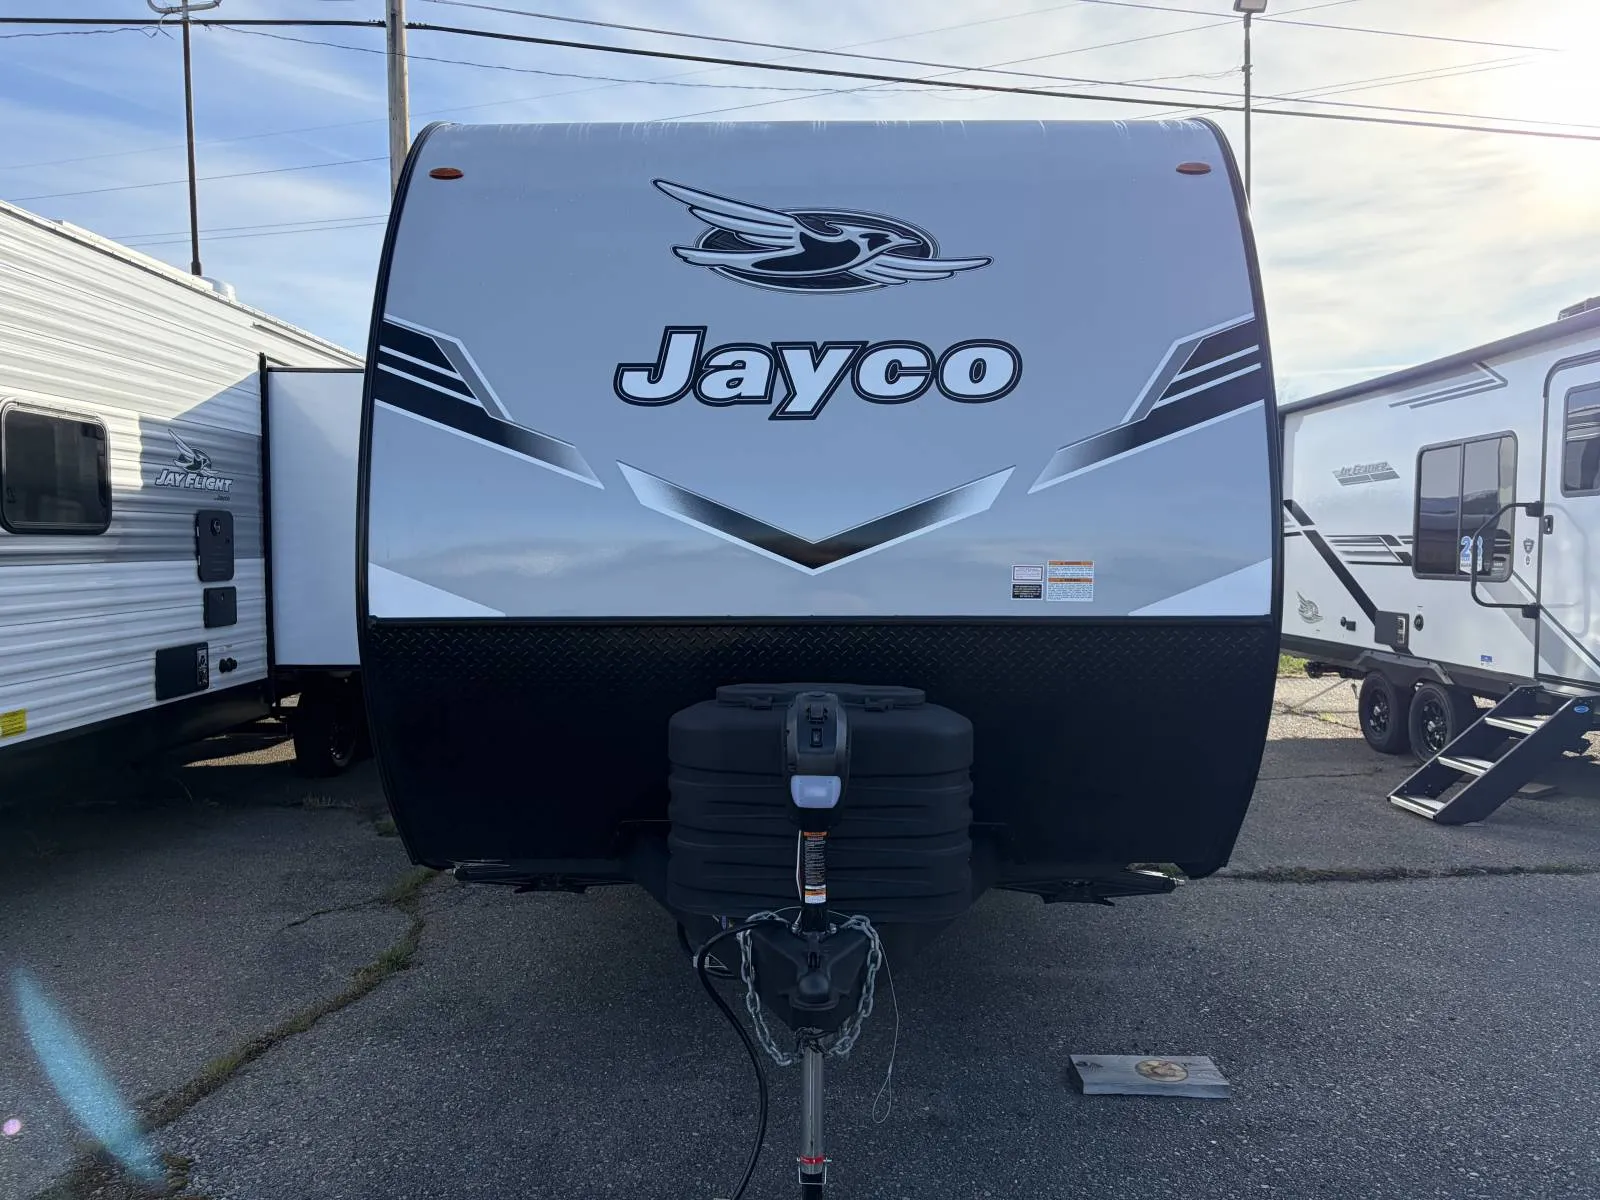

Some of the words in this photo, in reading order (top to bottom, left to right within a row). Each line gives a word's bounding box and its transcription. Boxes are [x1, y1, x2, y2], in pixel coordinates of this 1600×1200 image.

[613, 325, 1024, 421] Jayco
[155, 469, 185, 488] JAY
[184, 473, 233, 492] FLIGHT
